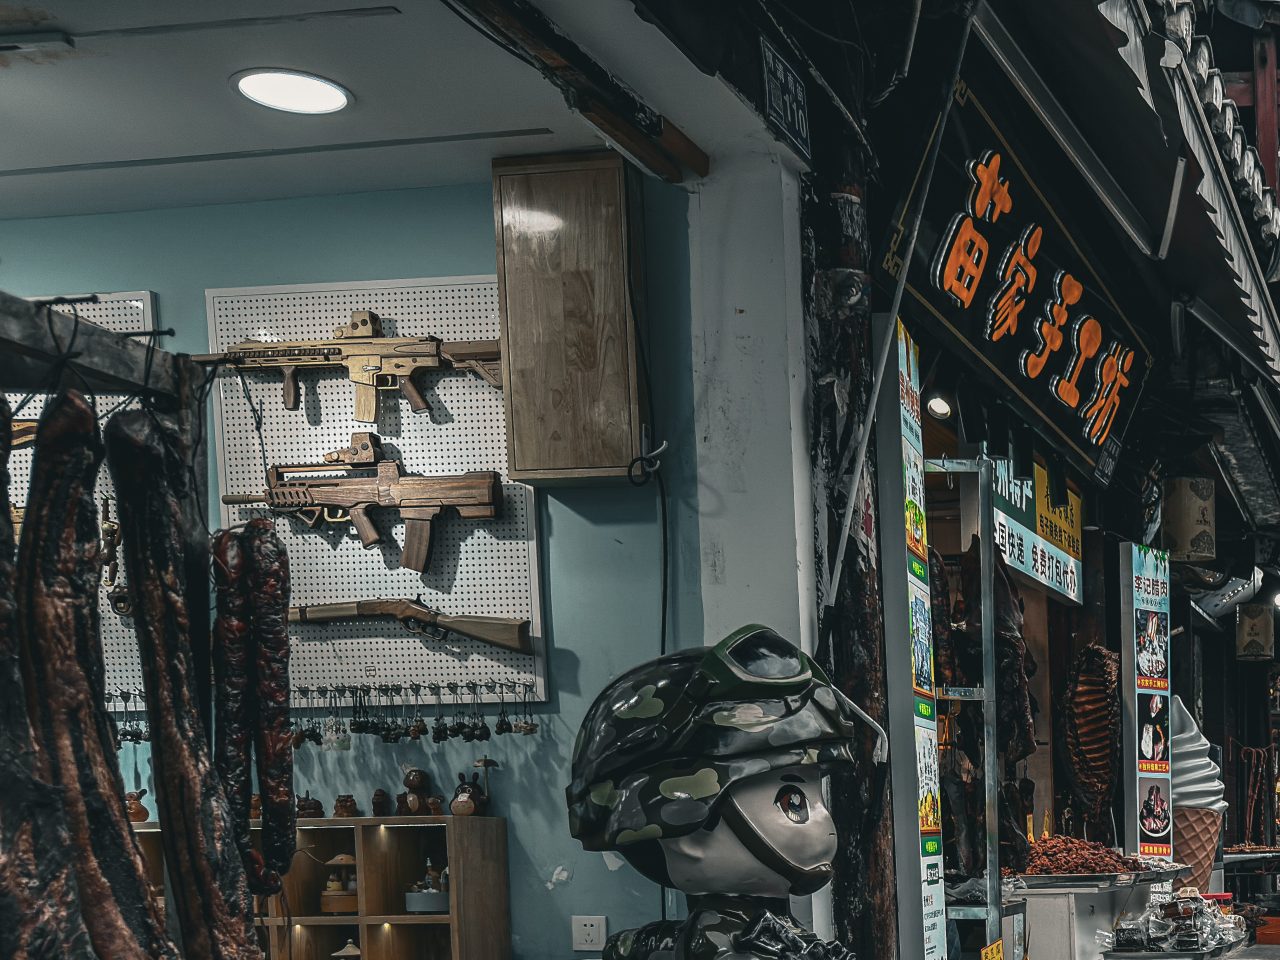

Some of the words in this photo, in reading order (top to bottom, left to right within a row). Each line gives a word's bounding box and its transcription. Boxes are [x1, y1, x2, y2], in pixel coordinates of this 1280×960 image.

[783, 93, 807, 138] 110
[939, 150, 1135, 447] 苗家手工坊
[992, 459, 1033, 513] 州特产
[1032, 541, 1077, 595] 免费打包代办
[1133, 574, 1168, 599] 李记腊肉
